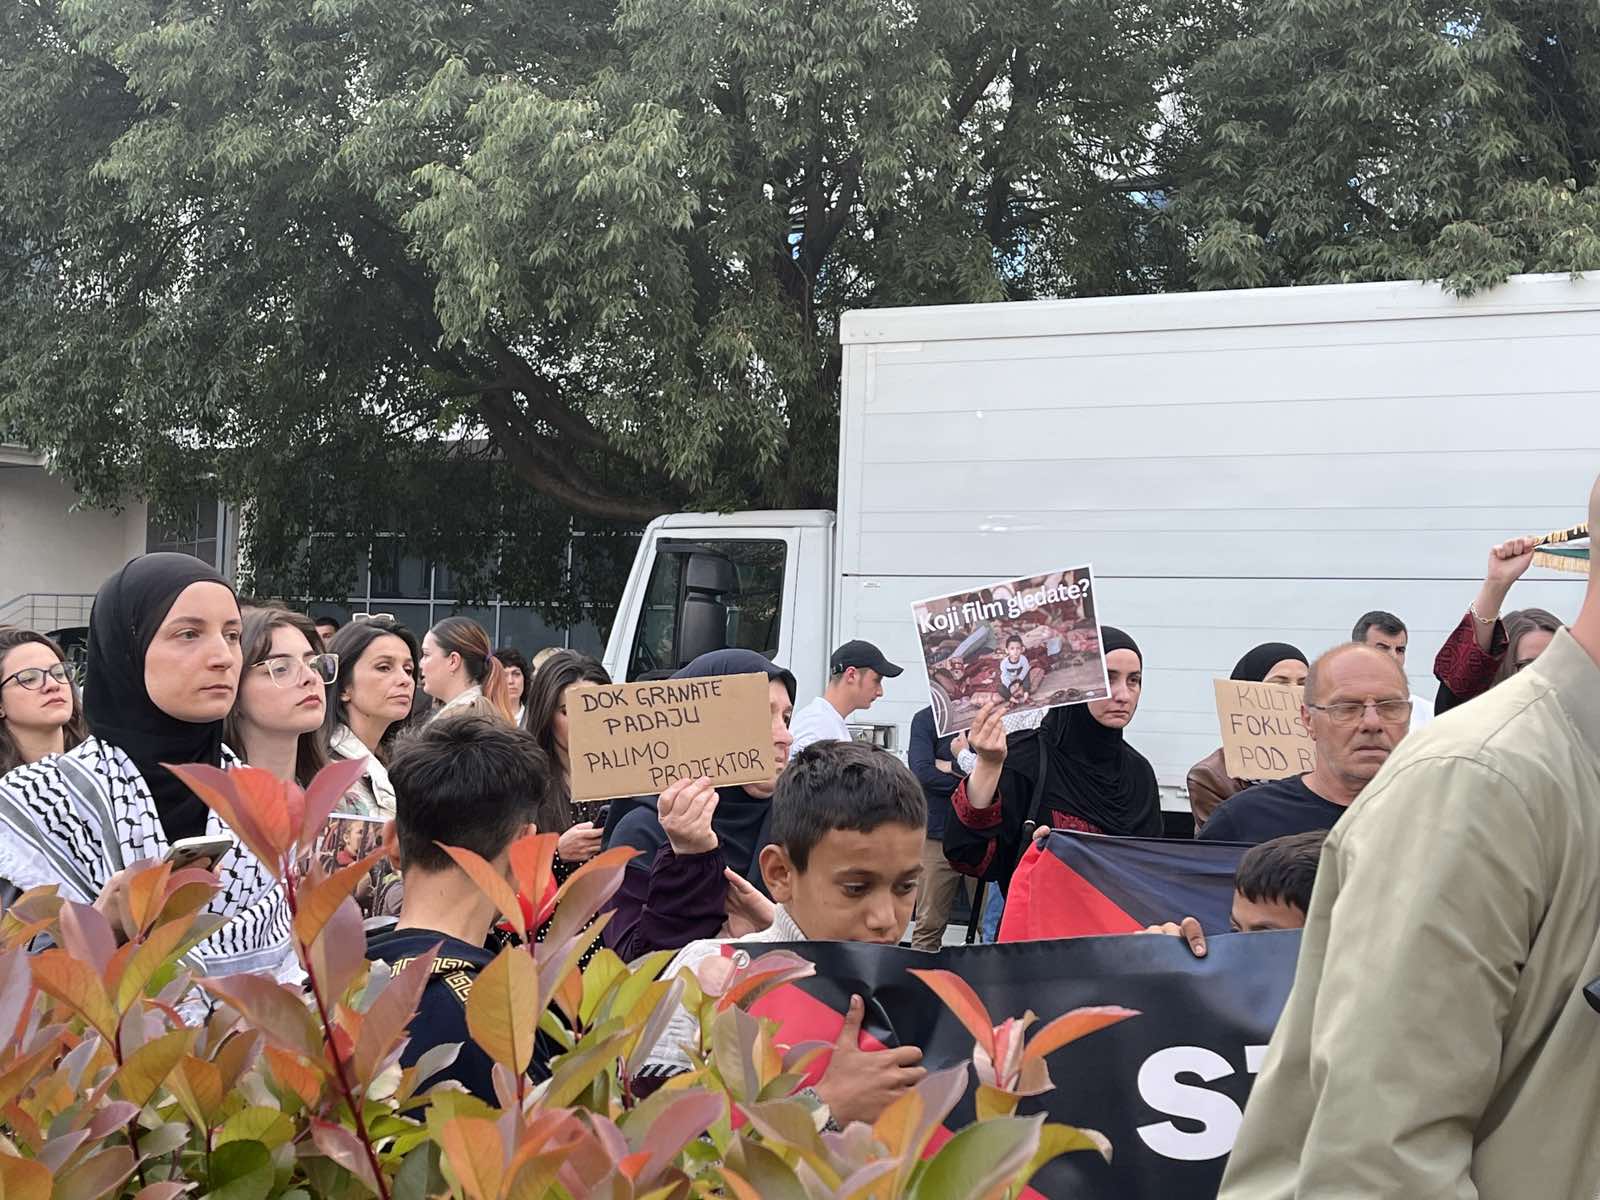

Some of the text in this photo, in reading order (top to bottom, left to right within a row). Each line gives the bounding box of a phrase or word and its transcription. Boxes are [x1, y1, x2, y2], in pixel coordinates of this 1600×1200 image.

[918, 578, 1090, 634] Koji film gledate?
[581, 679, 723, 712] DOK GRANATE
[603, 706, 701, 736] PADAJU
[584, 741, 670, 774] PALIMO
[649, 748, 765, 787] PROJEKTOR
[1240, 745, 1289, 771] POD
[1136, 1044, 1270, 1161] S
